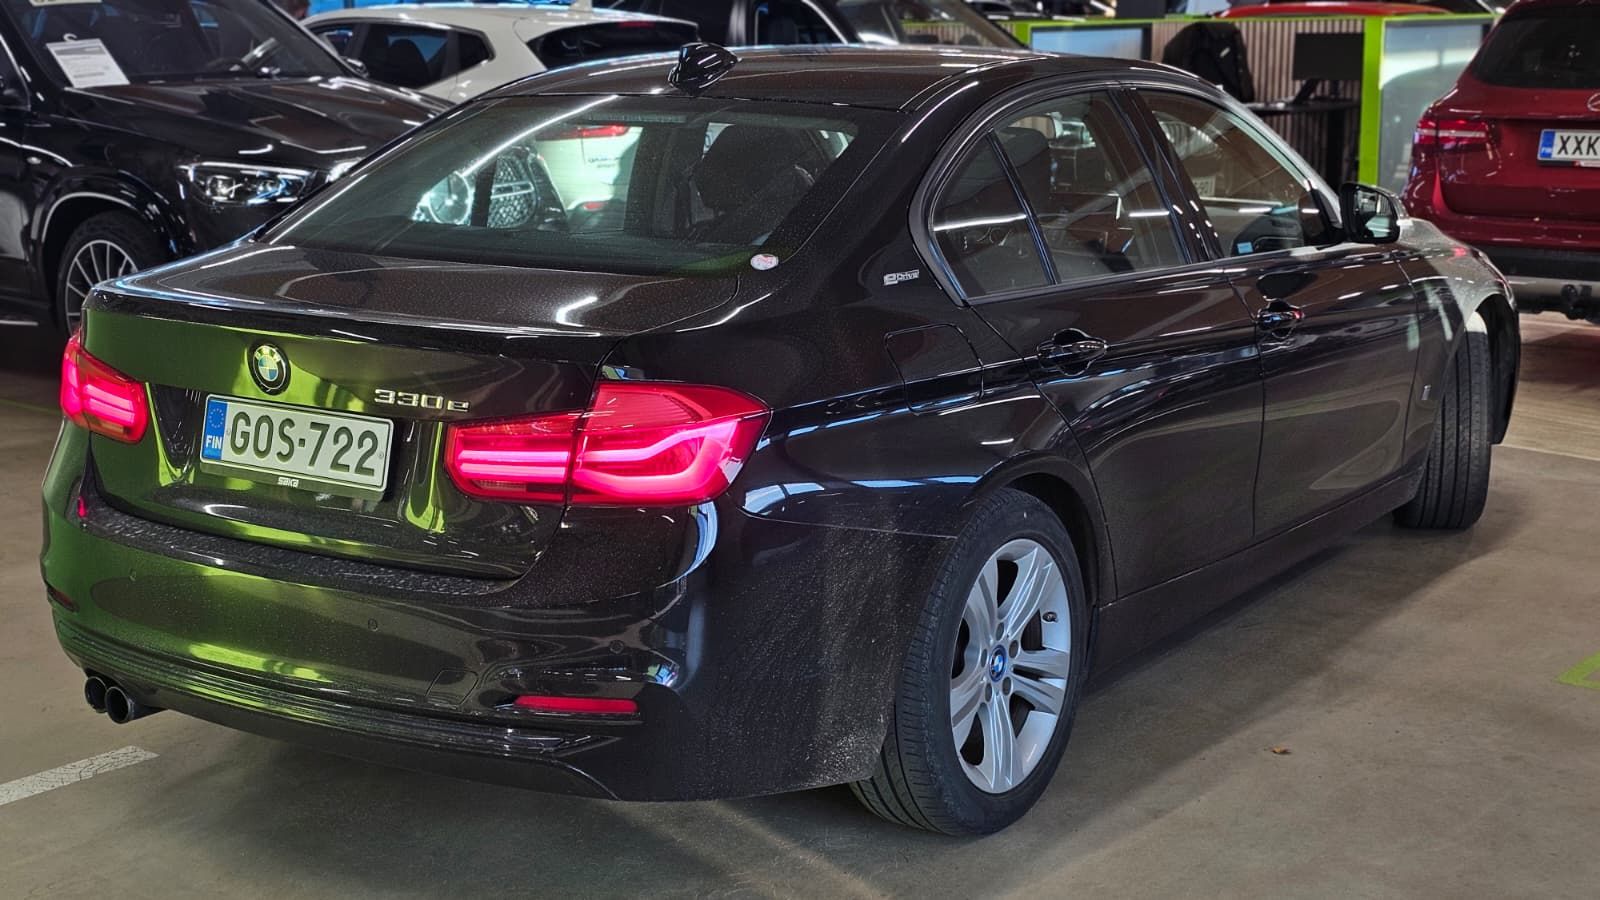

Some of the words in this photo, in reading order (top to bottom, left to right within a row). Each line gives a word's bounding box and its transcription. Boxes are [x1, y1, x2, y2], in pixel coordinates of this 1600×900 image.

[1557, 135, 1600, 156] XXK
[374, 388, 469, 412] 330e
[206, 435, 222, 449] FIN
[230, 411, 379, 477] GOS-722
